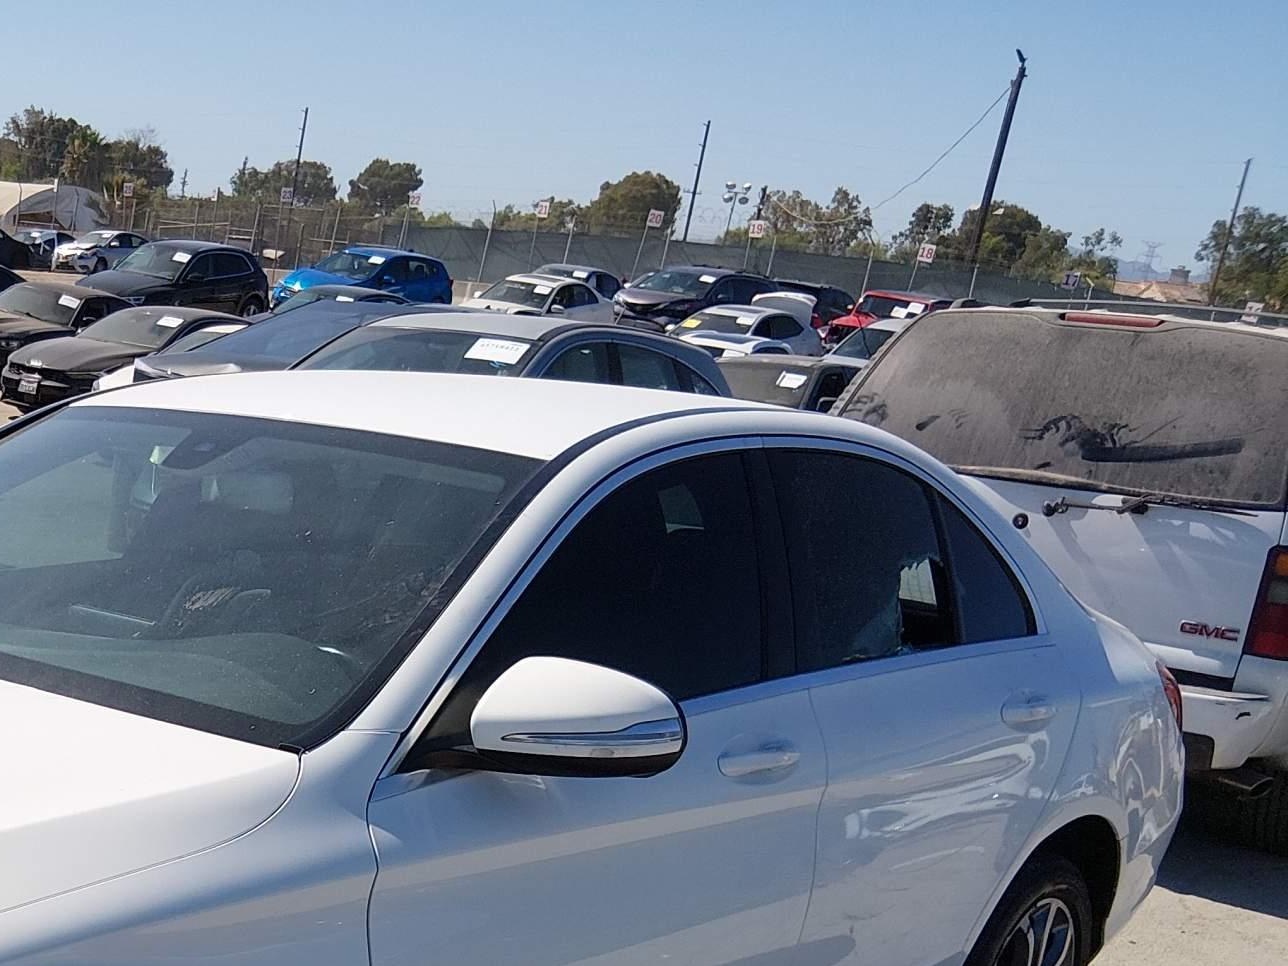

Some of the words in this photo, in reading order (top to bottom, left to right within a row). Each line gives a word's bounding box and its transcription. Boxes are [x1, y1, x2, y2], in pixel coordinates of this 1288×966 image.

[410, 195, 420, 205] 22
[537, 205, 548, 215] 21
[650, 212, 662, 224] 20
[751, 224, 762, 234] 19
[919, 247, 932, 259] 18
[1062, 273, 1078, 287] 17
[1179, 620, 1241, 642] GMC
